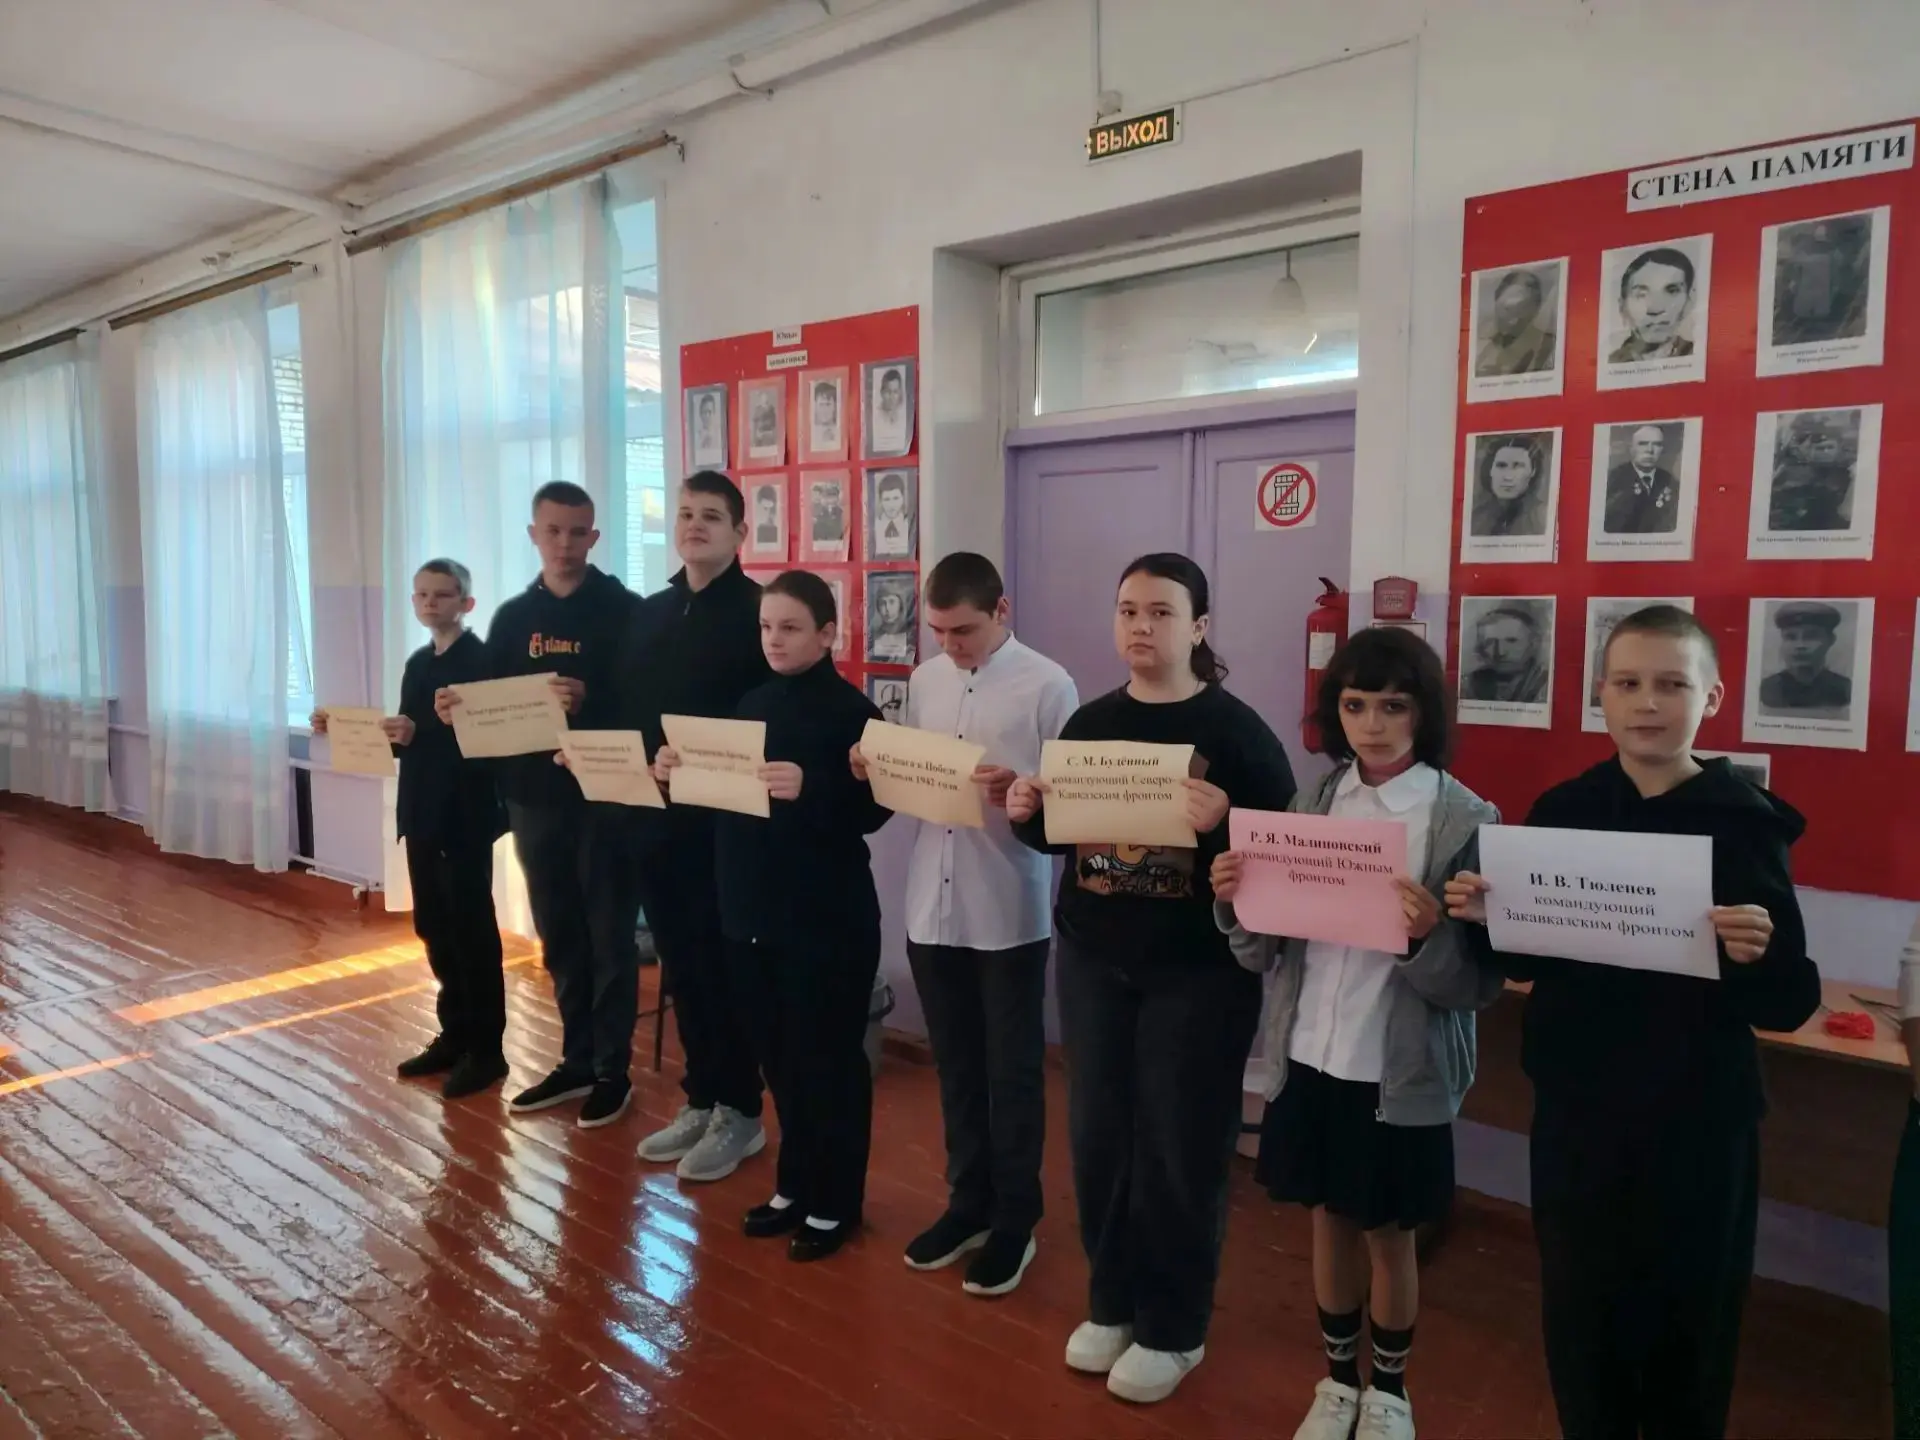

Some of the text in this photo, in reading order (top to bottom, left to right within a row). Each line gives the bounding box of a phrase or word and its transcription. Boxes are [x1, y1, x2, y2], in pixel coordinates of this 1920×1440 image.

[1096, 116, 1168, 154] ВЫХОД
[1631, 135, 1907, 201] СТЕНА ПАМЯТИ
[1066, 755, 1077, 766] С.
[1083, 756, 1097, 767] М.
[1052, 775, 1129, 787] командующий
[1123, 789, 1172, 803] фронтом
[1250, 830, 1382, 854] Р. Я. Малиновский
[1242, 851, 1394, 876] командующий Южным
[1288, 869, 1345, 887] фронтом
[1530, 873, 1657, 896] И. В. Тюленев
[1534, 894, 1656, 917] командующий
[1502, 907, 1696, 941] Закавказским фронтом
